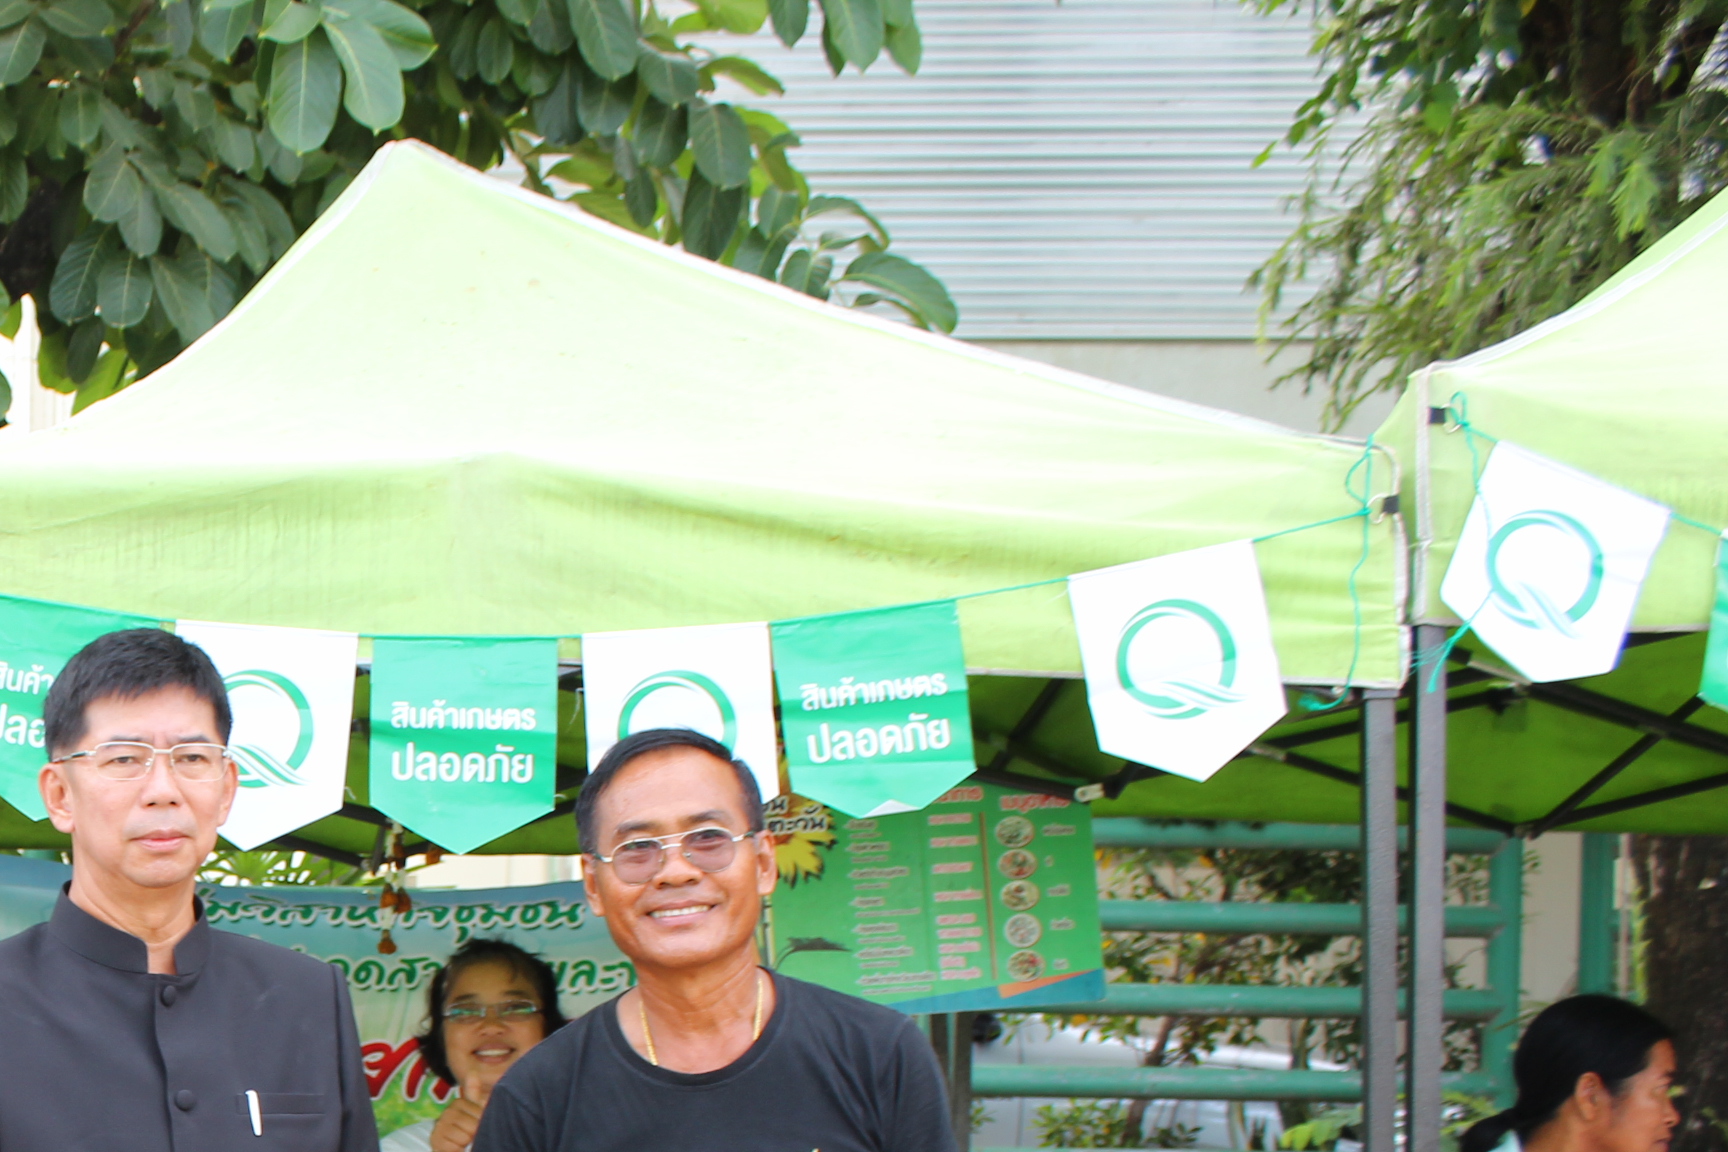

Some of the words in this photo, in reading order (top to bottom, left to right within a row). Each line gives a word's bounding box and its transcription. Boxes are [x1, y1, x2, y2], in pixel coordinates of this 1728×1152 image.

[800, 671, 948, 711] สินค้าเกษตร
[390, 699, 536, 731] สินค้าเกษตร
[806, 711, 952, 764] ปลอดภัย
[391, 742, 535, 783] ปลอดภัย
